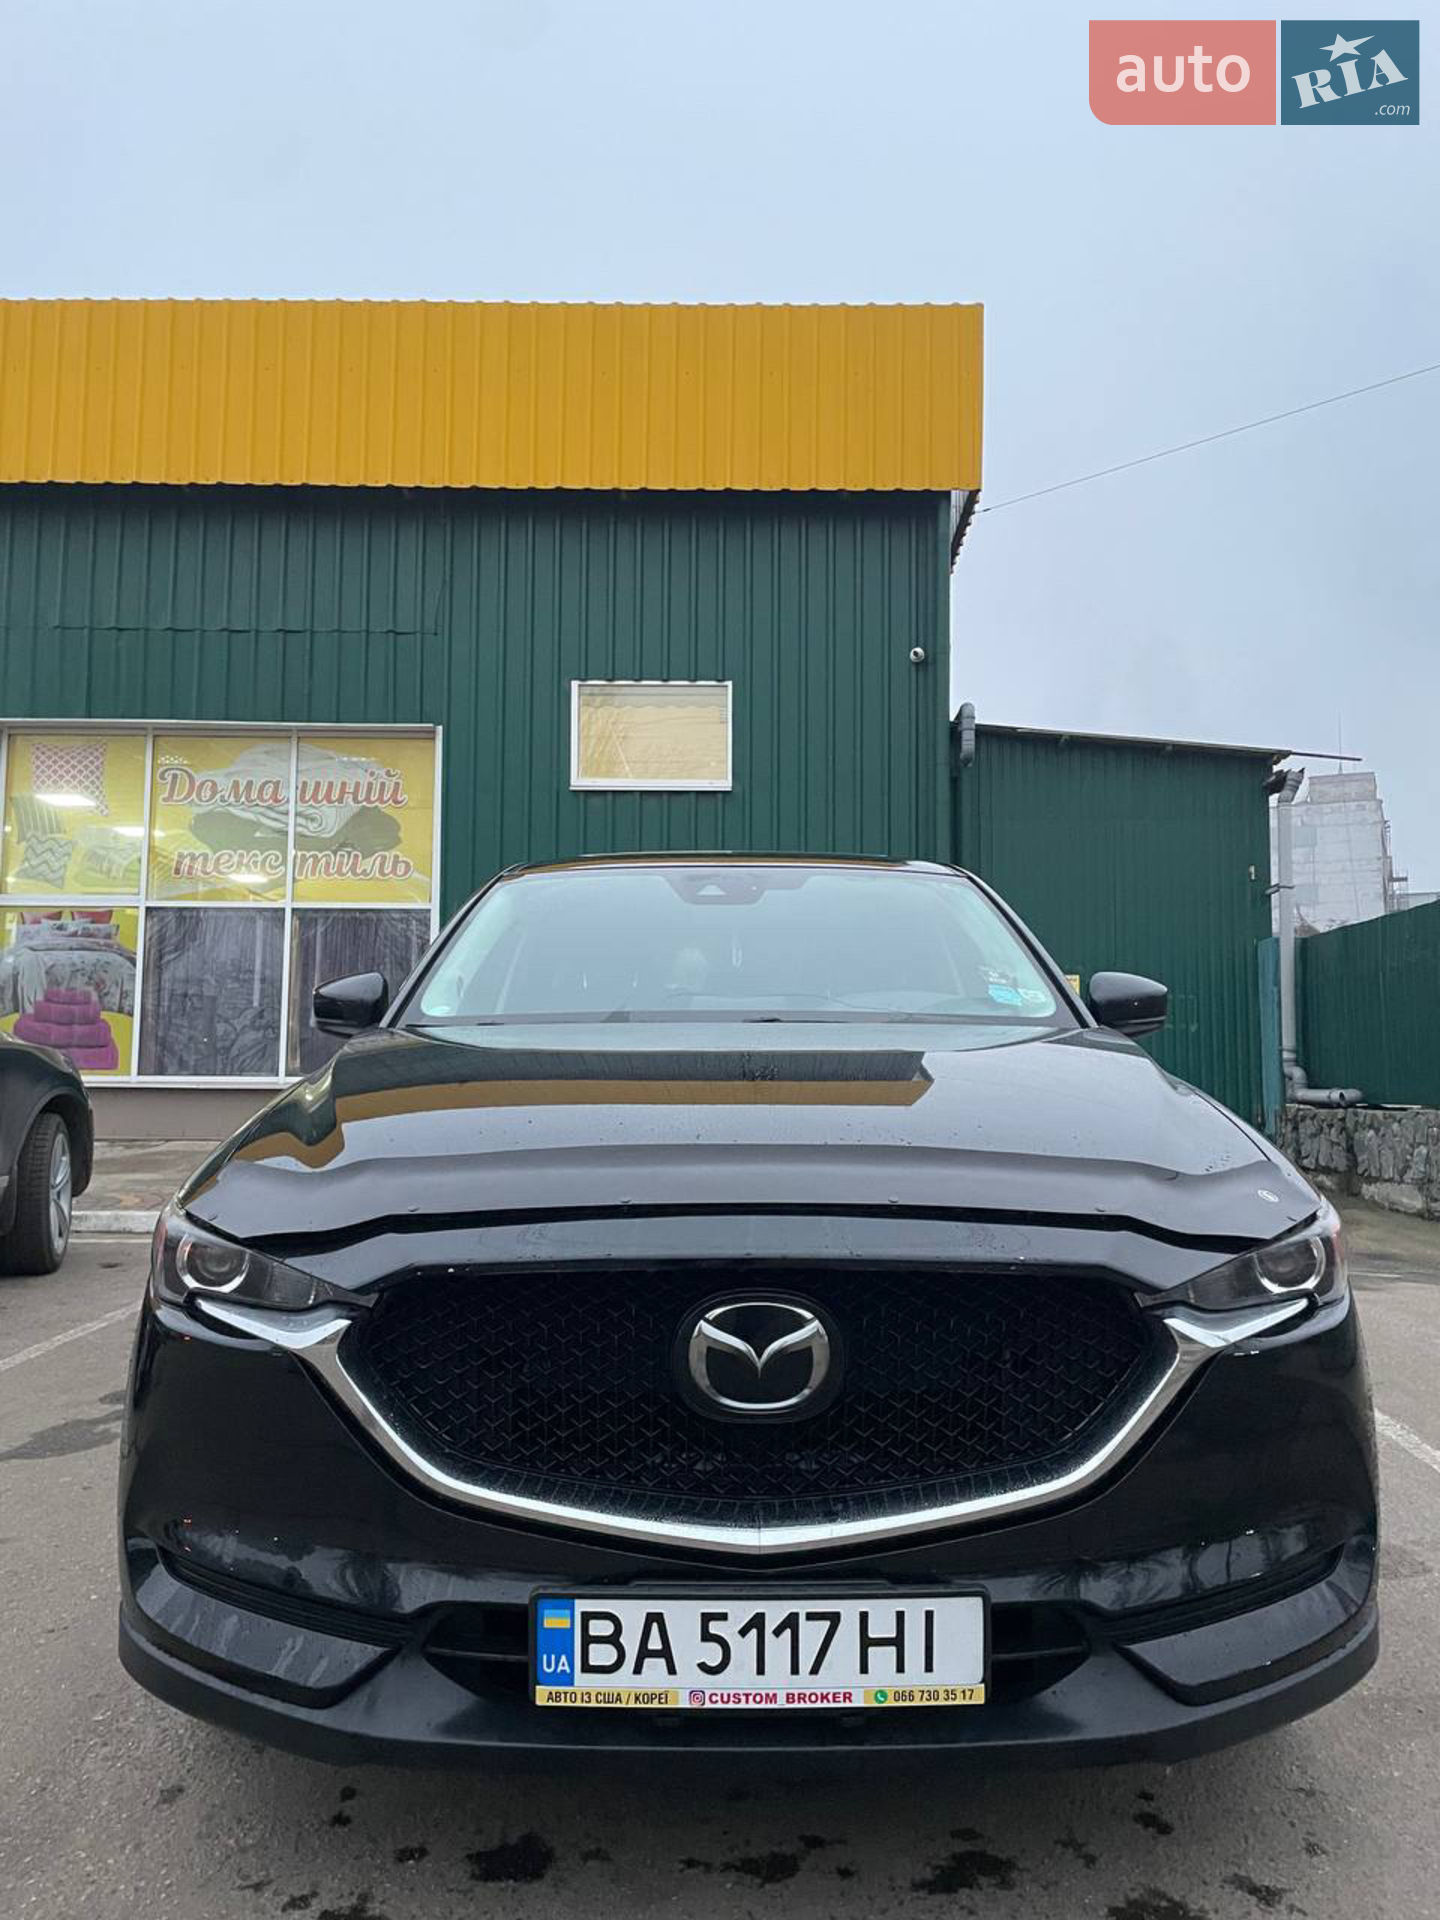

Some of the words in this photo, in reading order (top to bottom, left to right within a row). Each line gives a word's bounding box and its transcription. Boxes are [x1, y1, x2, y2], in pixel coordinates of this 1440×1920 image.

[158, 766, 408, 807] Домашній
[173, 849, 414, 879] текстиль
[580, 1611, 677, 1675] BA
[696, 1611, 842, 1676] 5117
[859, 1609, 935, 1675] HI
[542, 1654, 571, 1673] UA
[546, 1691, 577, 1703] АВТО
[595, 1692, 622, 1704] США
[633, 1690, 669, 1705] КОРЕЇ
[893, 1690, 915, 1702] 066
[918, 1689, 940, 1702] 730
[943, 1689, 957, 1701] 35
[960, 1688, 974, 1700] 17
